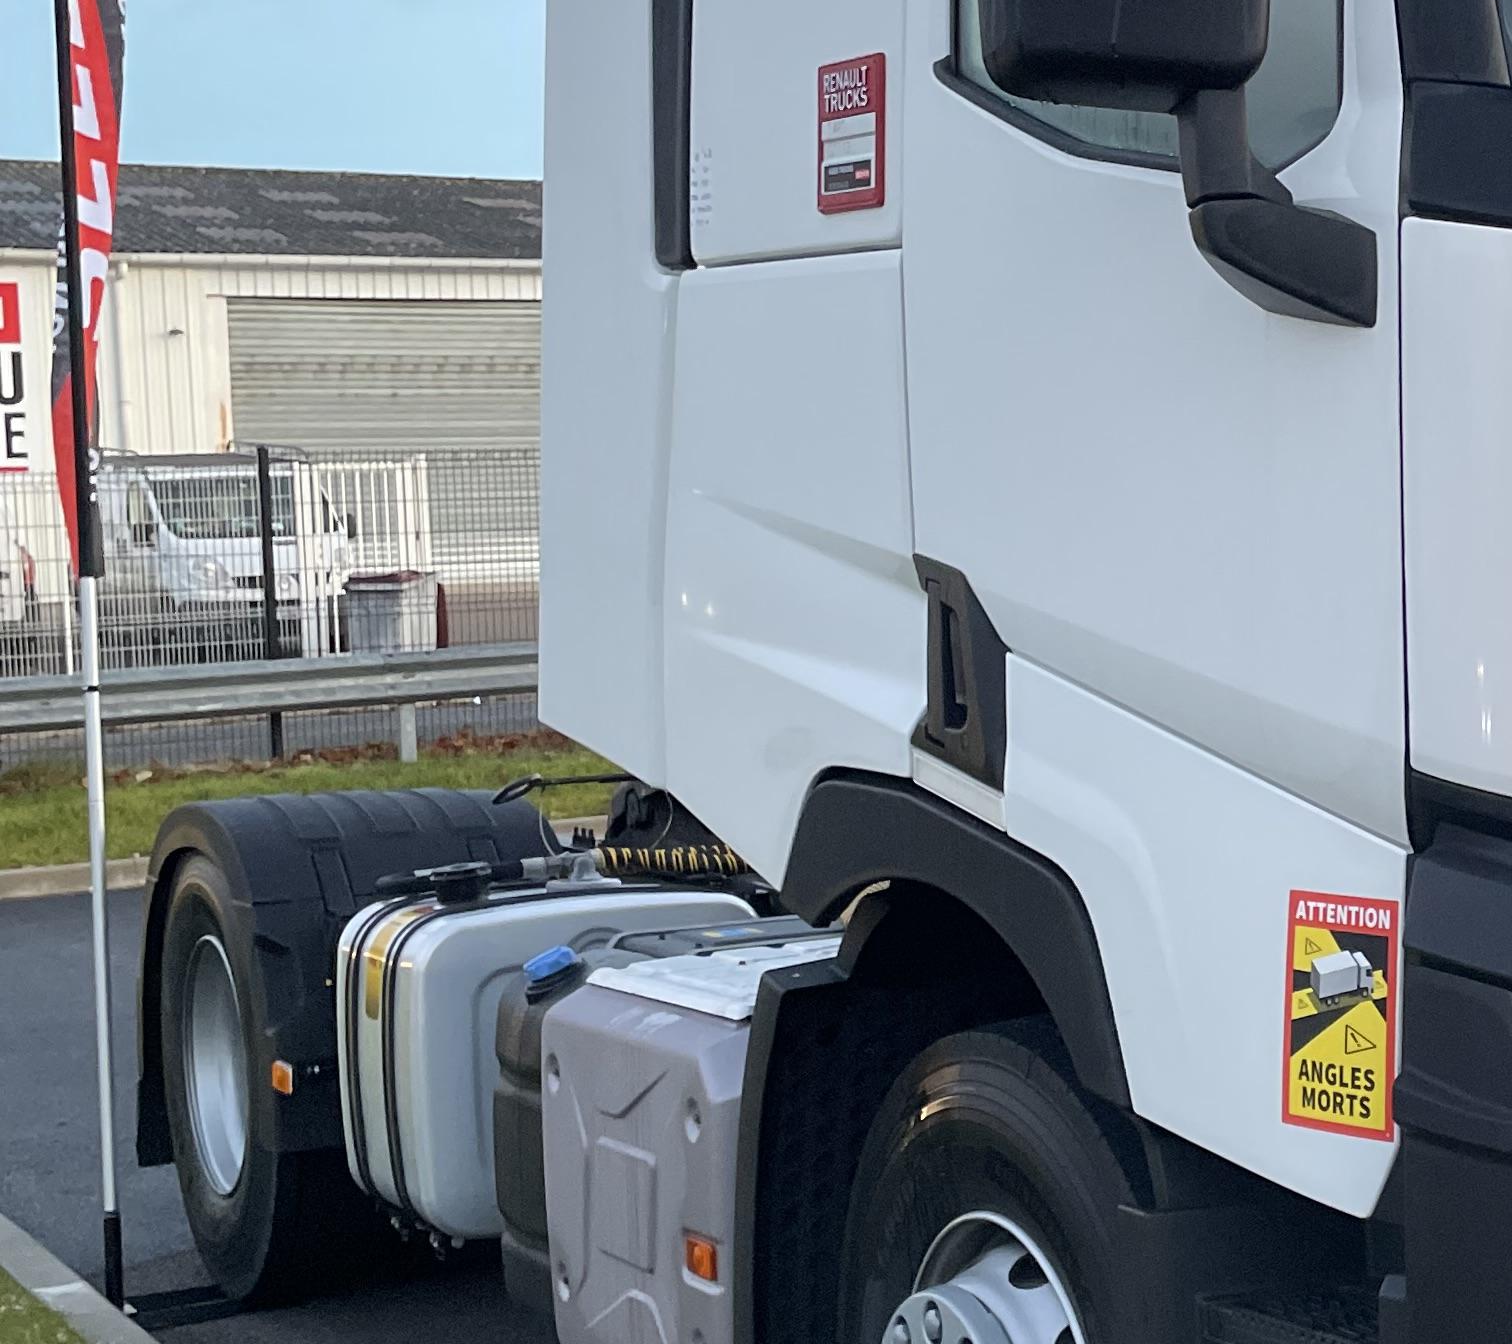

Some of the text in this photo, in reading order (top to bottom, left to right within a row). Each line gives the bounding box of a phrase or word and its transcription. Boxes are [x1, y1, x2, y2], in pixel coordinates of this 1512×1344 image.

[823, 65, 869, 94] RENAULT
[823, 88, 869, 113] TRUCKS
[1295, 899, 1392, 930] ATTENTION
[1298, 1058, 1376, 1093] ANGLES
[1301, 1085, 1372, 1119] MORTS
